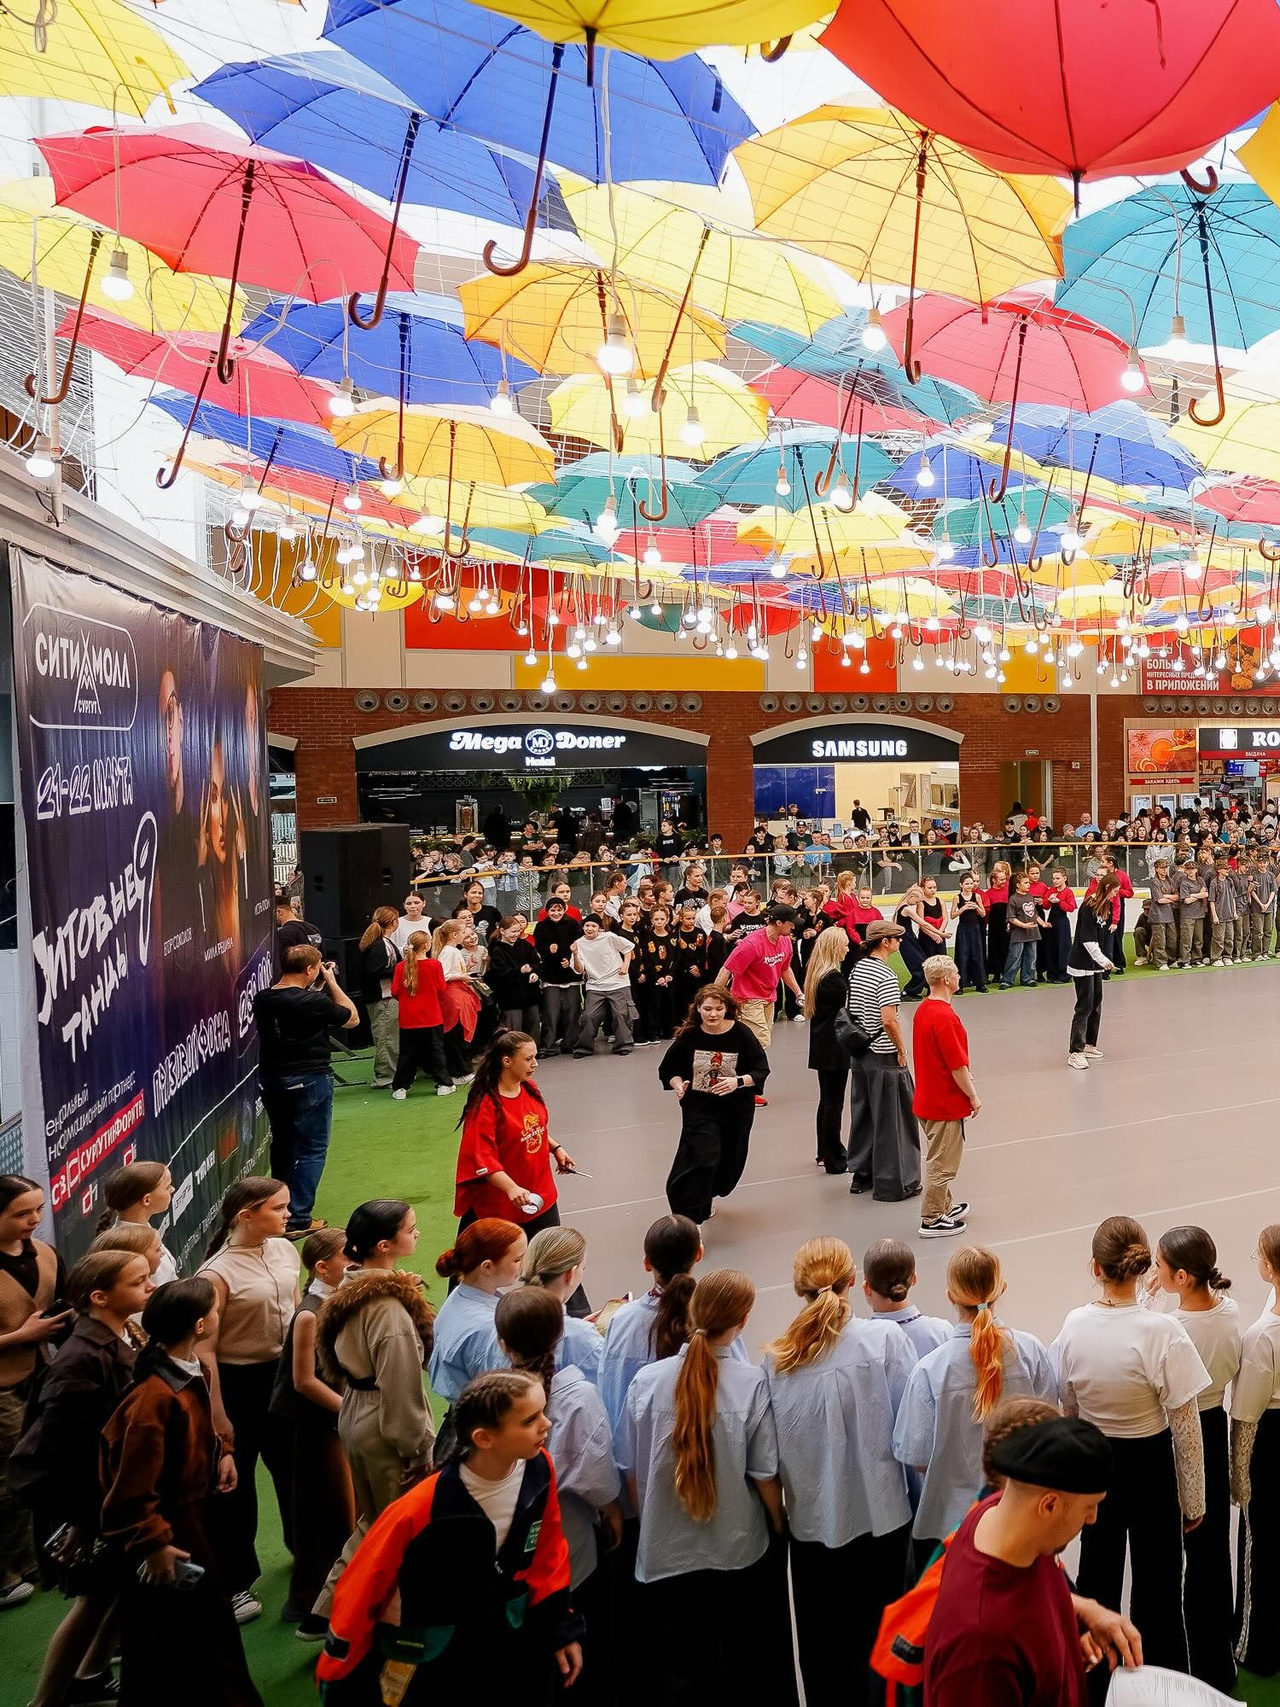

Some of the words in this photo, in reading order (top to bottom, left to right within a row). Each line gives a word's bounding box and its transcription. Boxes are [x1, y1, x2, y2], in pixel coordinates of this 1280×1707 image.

[1147, 659, 1186, 669] БОЛЬЕ
[1147, 680, 1153, 690] В
[1155, 680, 1219, 691] ПРИЛОЖЕНИИ
[450, 732, 522, 753] Mega
[555, 732, 626, 749] Doner
[812, 740, 908, 758] SAMSUNG
[525, 756, 556, 766] Halal
[62, 932, 128, 1063] ТАНЦЫ
